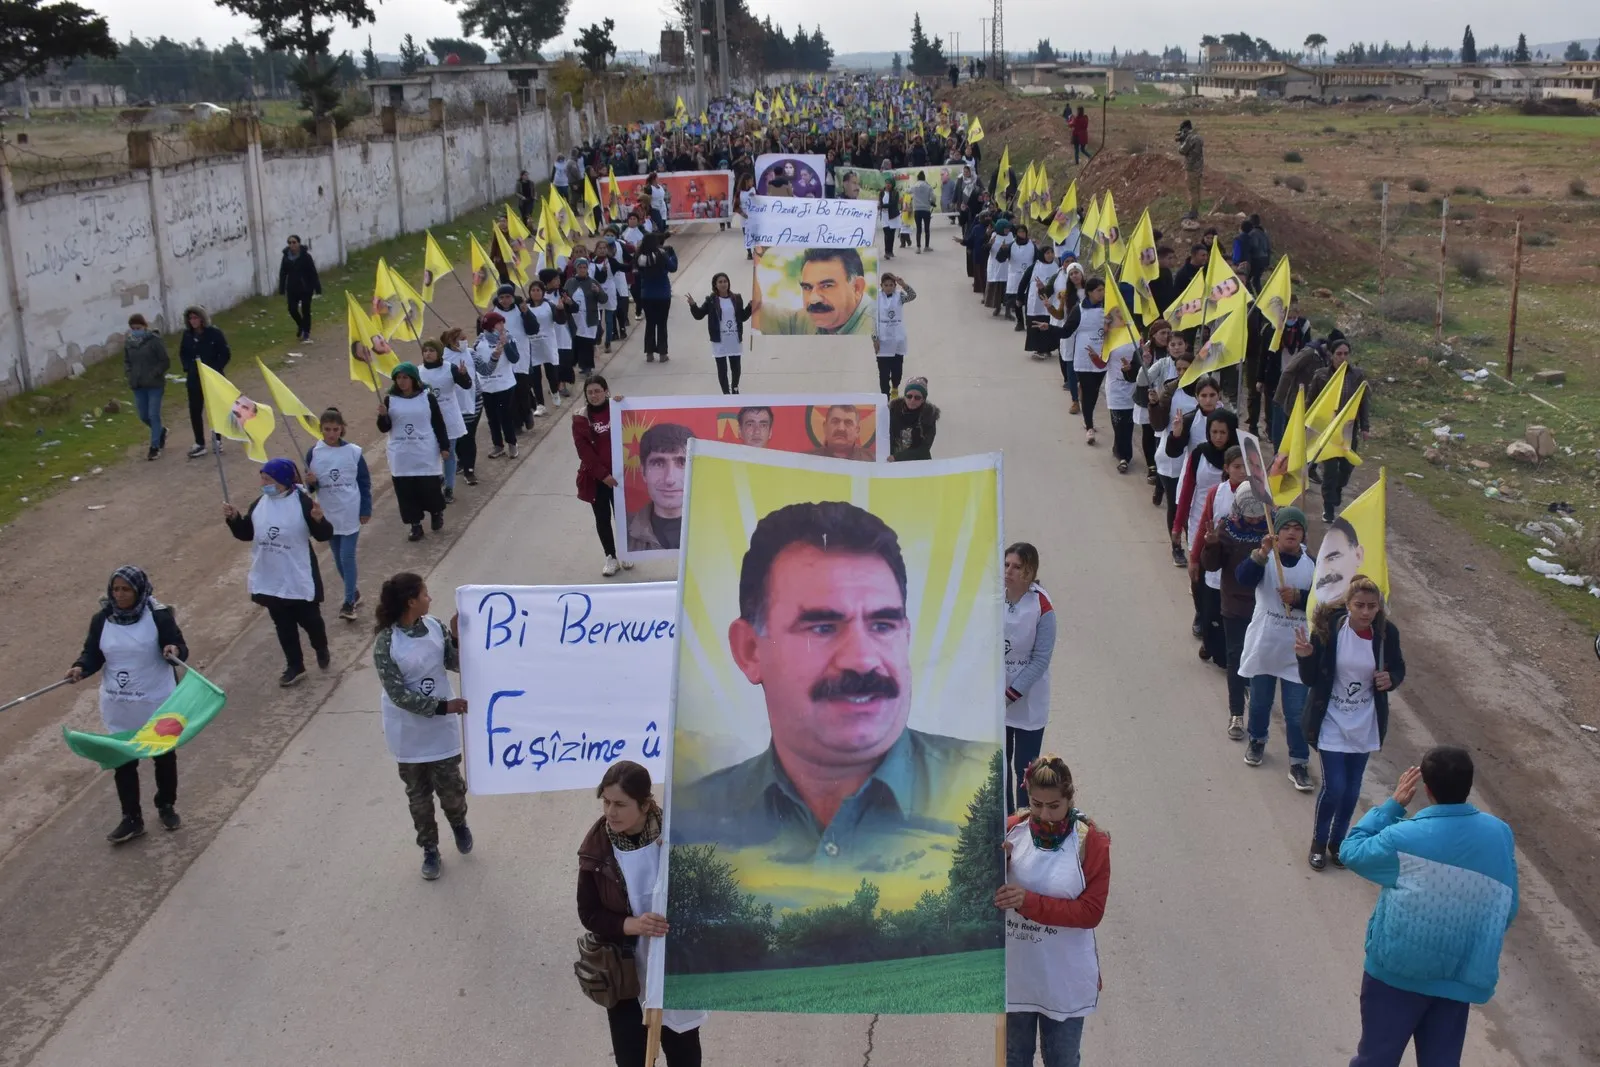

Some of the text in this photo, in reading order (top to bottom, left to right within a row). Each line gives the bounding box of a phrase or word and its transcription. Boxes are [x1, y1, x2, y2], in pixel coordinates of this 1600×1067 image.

[797, 202, 812, 217] Ji
[816, 199, 831, 216] Bo
[776, 227, 810, 246] Azad
[849, 227, 872, 247] Apo
[478, 591, 529, 650] Bi
[486, 690, 661, 771] Faşîzime û
[1044, 926, 1058, 936] Apo
